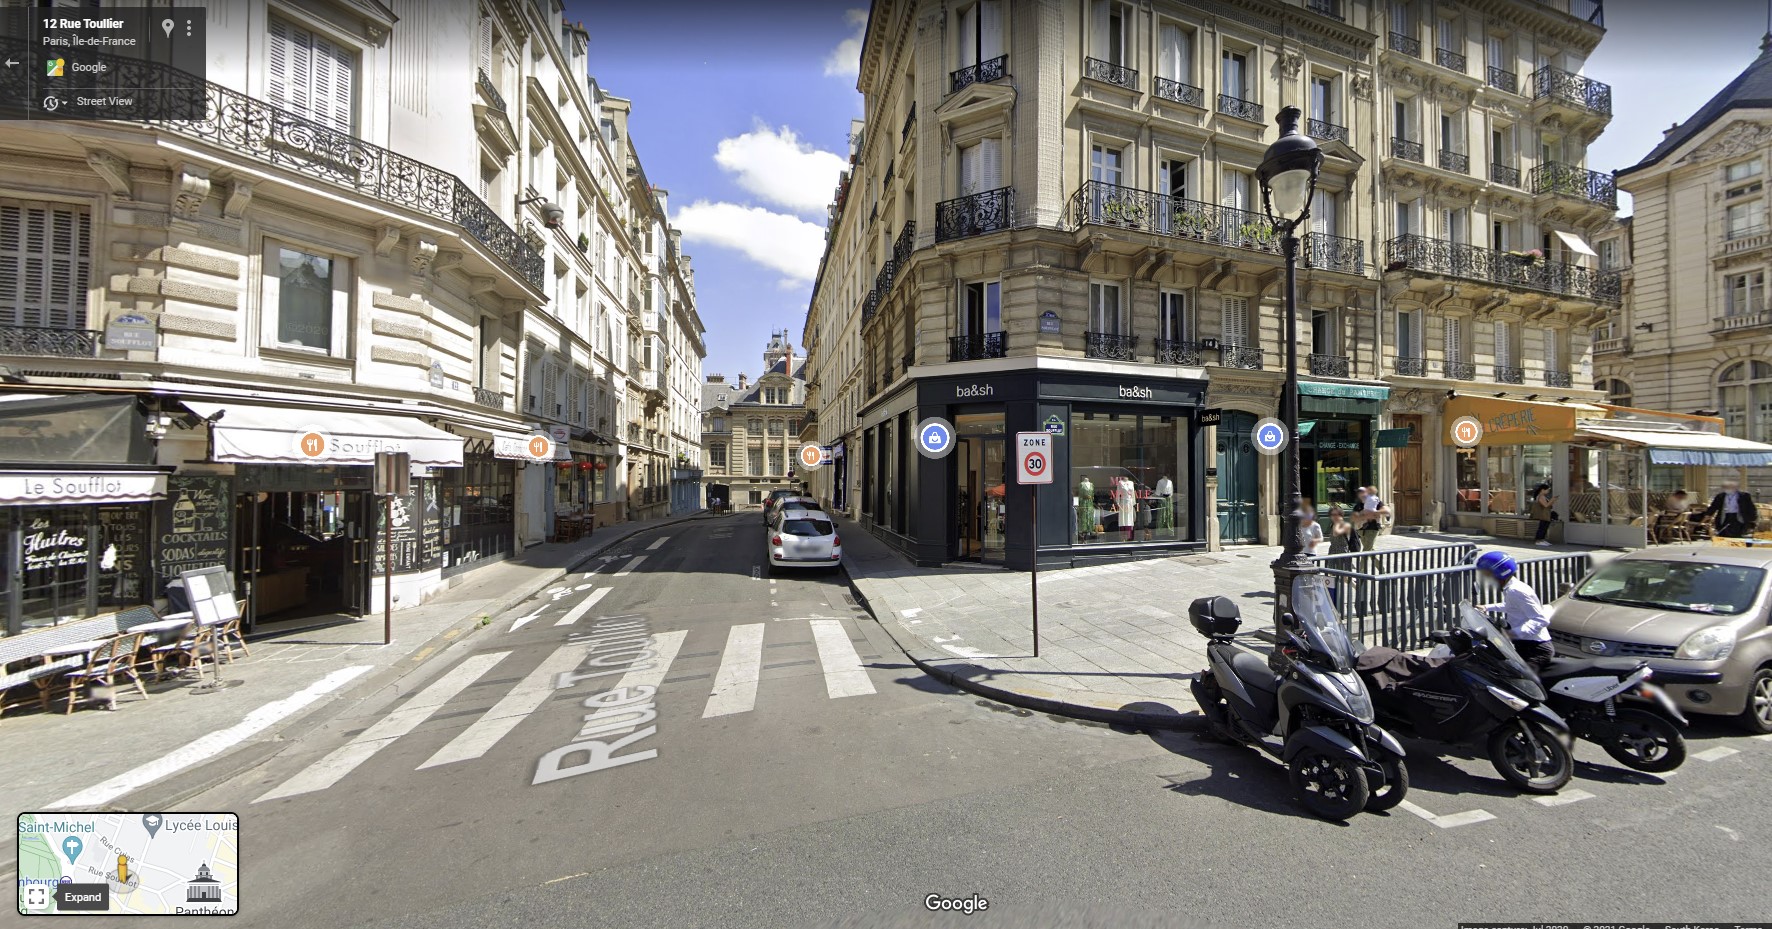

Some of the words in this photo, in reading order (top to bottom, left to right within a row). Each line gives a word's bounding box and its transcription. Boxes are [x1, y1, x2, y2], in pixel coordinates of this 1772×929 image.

[956, 383, 994, 397] ba&sh
[1119, 384, 1153, 399] ba&sh
[1201, 413, 1220, 423] ba&sh
[1023, 438, 1046, 447] ZONE
[1028, 458, 1042, 469] 30
[25, 478, 45, 496] Le
[53, 476, 123, 495] Soufflot
[161, 531, 228, 544] COCKTAILS
[161, 546, 195, 561] SODAS
[1603, 683, 1620, 692] Uber
